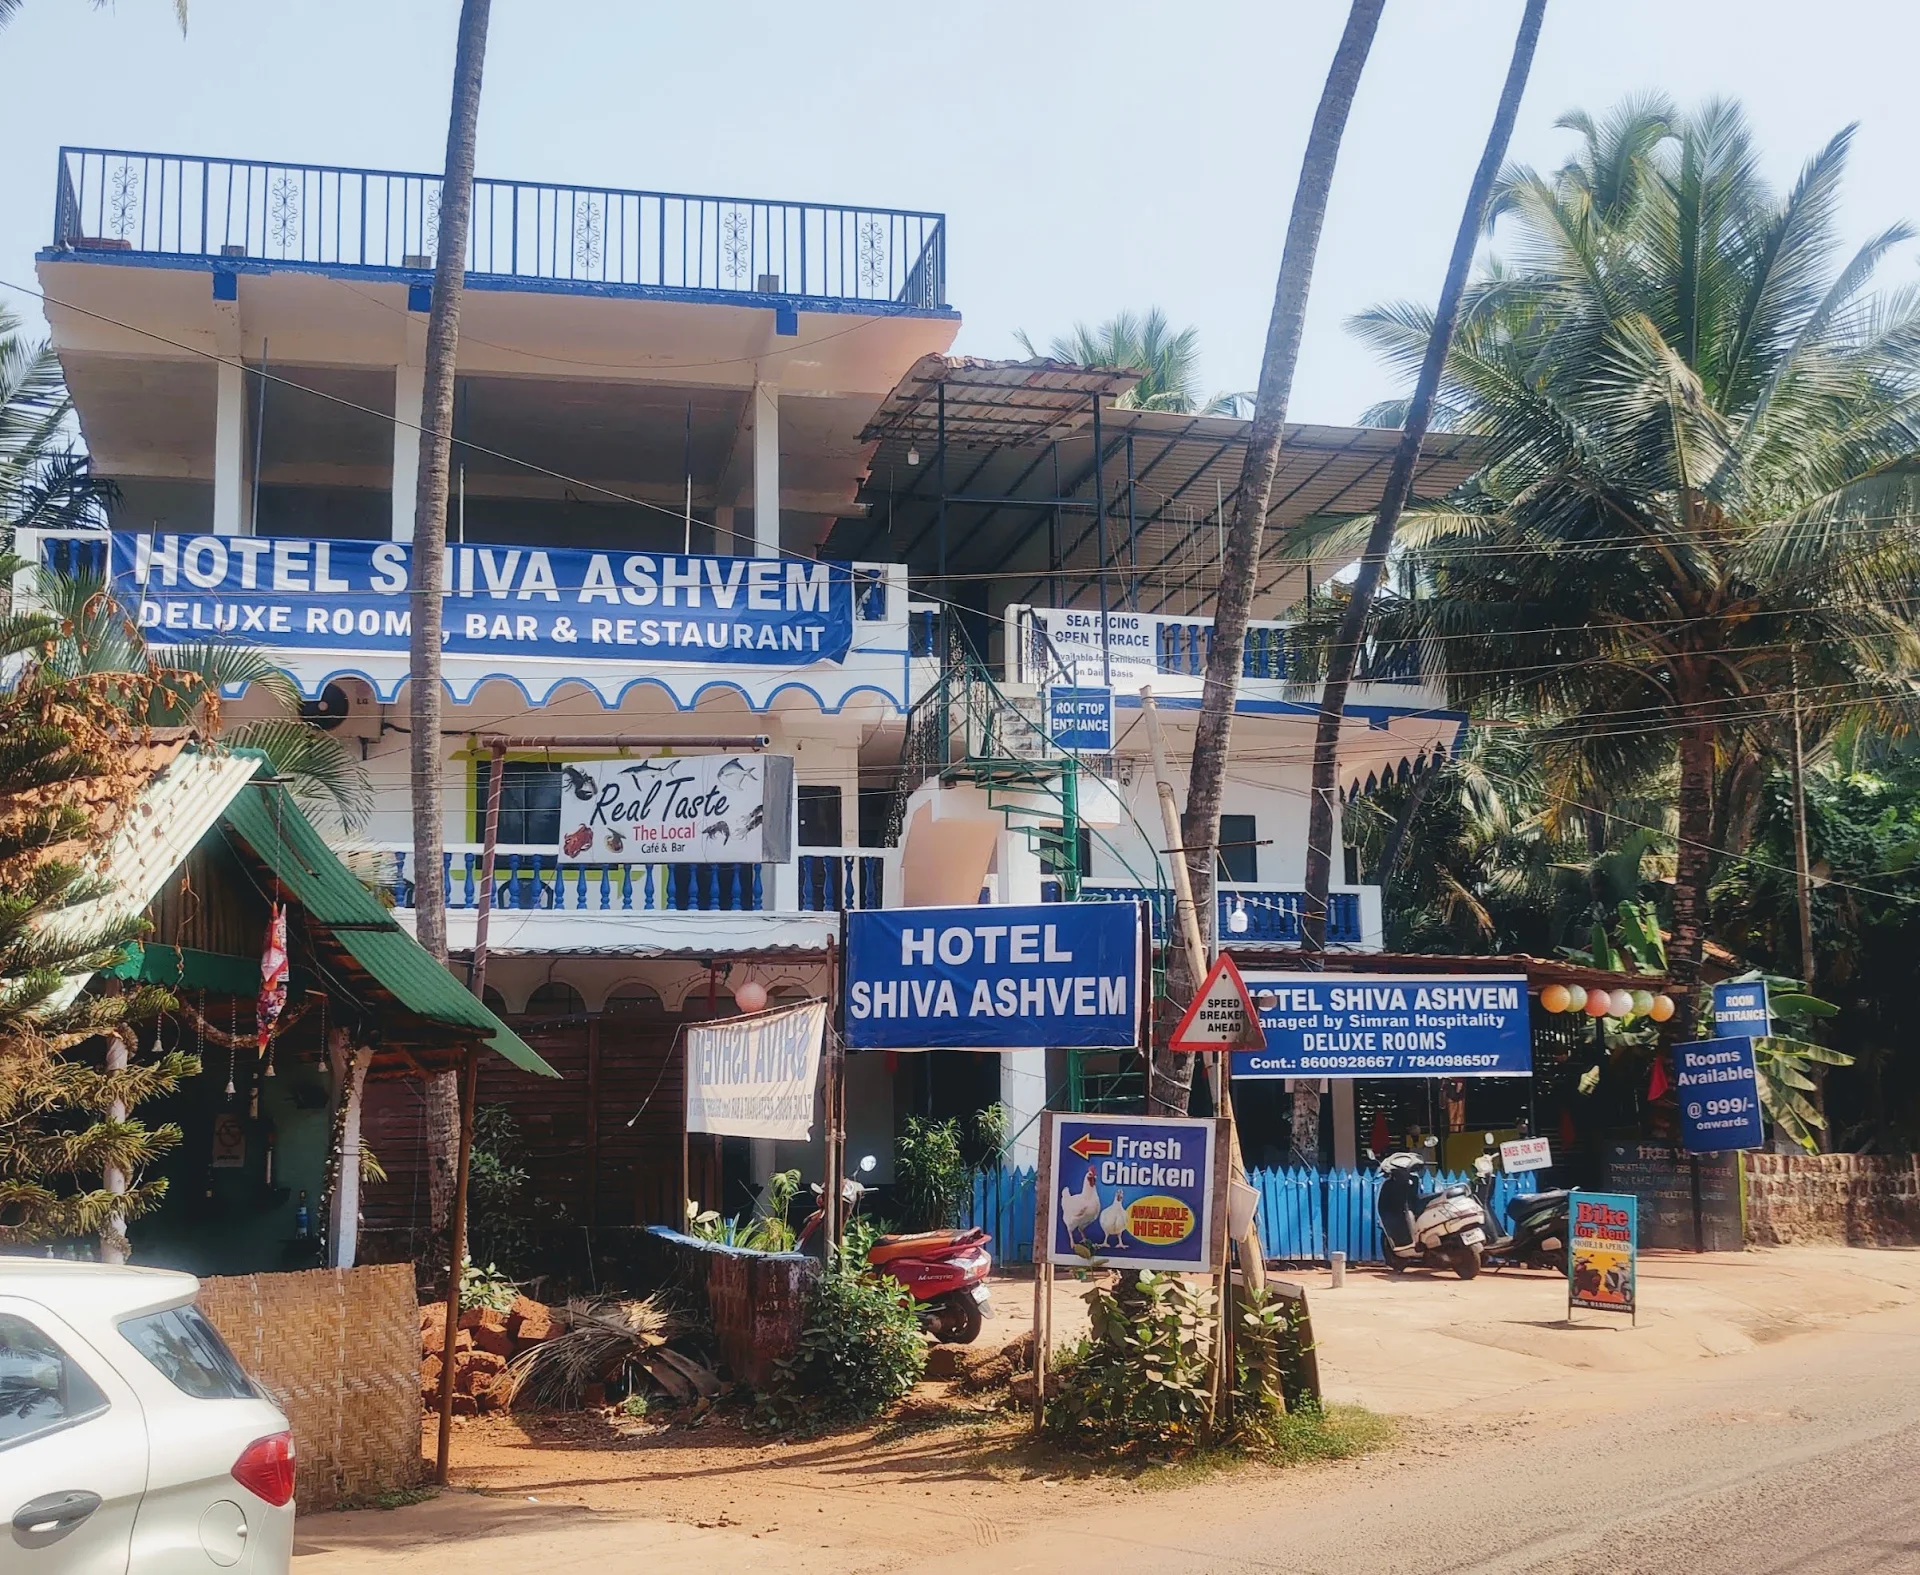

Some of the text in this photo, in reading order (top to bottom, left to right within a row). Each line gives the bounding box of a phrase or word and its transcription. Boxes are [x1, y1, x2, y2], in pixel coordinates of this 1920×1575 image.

[135, 534, 349, 592] HOTEL
[577, 554, 830, 613] ASHVEM
[139, 601, 825, 652] DELUXE ROOM, BAR & RESTAURANT
[1066, 614, 1139, 630] SEA FCING
[1055, 631, 1150, 647] OPEN TRRACE
[1059, 653, 1093, 662] vailable
[1110, 655, 1151, 665] Exhibition
[1087, 668, 1104, 677] Dail
[1111, 669, 1134, 678] Basis
[590, 776, 730, 826] Real Taste
[633, 822, 696, 841] The Local
[641, 842, 686, 854] Café & Bar
[901, 924, 1073, 966] HOTEL
[850, 976, 1127, 1020] SHIVA ASHVEM
[1207, 998, 1240, 1008] SPEED
[1249, 987, 1519, 1012] OTEL SHIVA ASHVEM
[1725, 995, 1755, 1008] ROOM
[1200, 1010, 1245, 1020] BREAKER
[1259, 1013, 1505, 1030] anaged by Simran Hospitality
[1715, 1009, 1766, 1022] ENTRANCE
[1207, 1023, 1241, 1032] AHEAD
[1303, 1031, 1447, 1051] DELUXE ROOMS
[1250, 1055, 1500, 1069] Cont.: 8600928667 / 7840986507
[1685, 1050, 1741, 1068] Rooms
[1678, 1065, 1754, 1087] Available
[1687, 1097, 1755, 1119] @ 999/-
[1696, 1116, 1749, 1131] onwards
[1116, 1136, 1181, 1160] Fresh
[1503, 1146, 1519, 1157] BIKES
[1101, 1161, 1195, 1188] Chicken
[1131, 1205, 1189, 1221] AVAILABLE
[1576, 1201, 1629, 1227] Bike
[1133, 1220, 1185, 1239] HERE
[1574, 1222, 1631, 1241] for Rent
